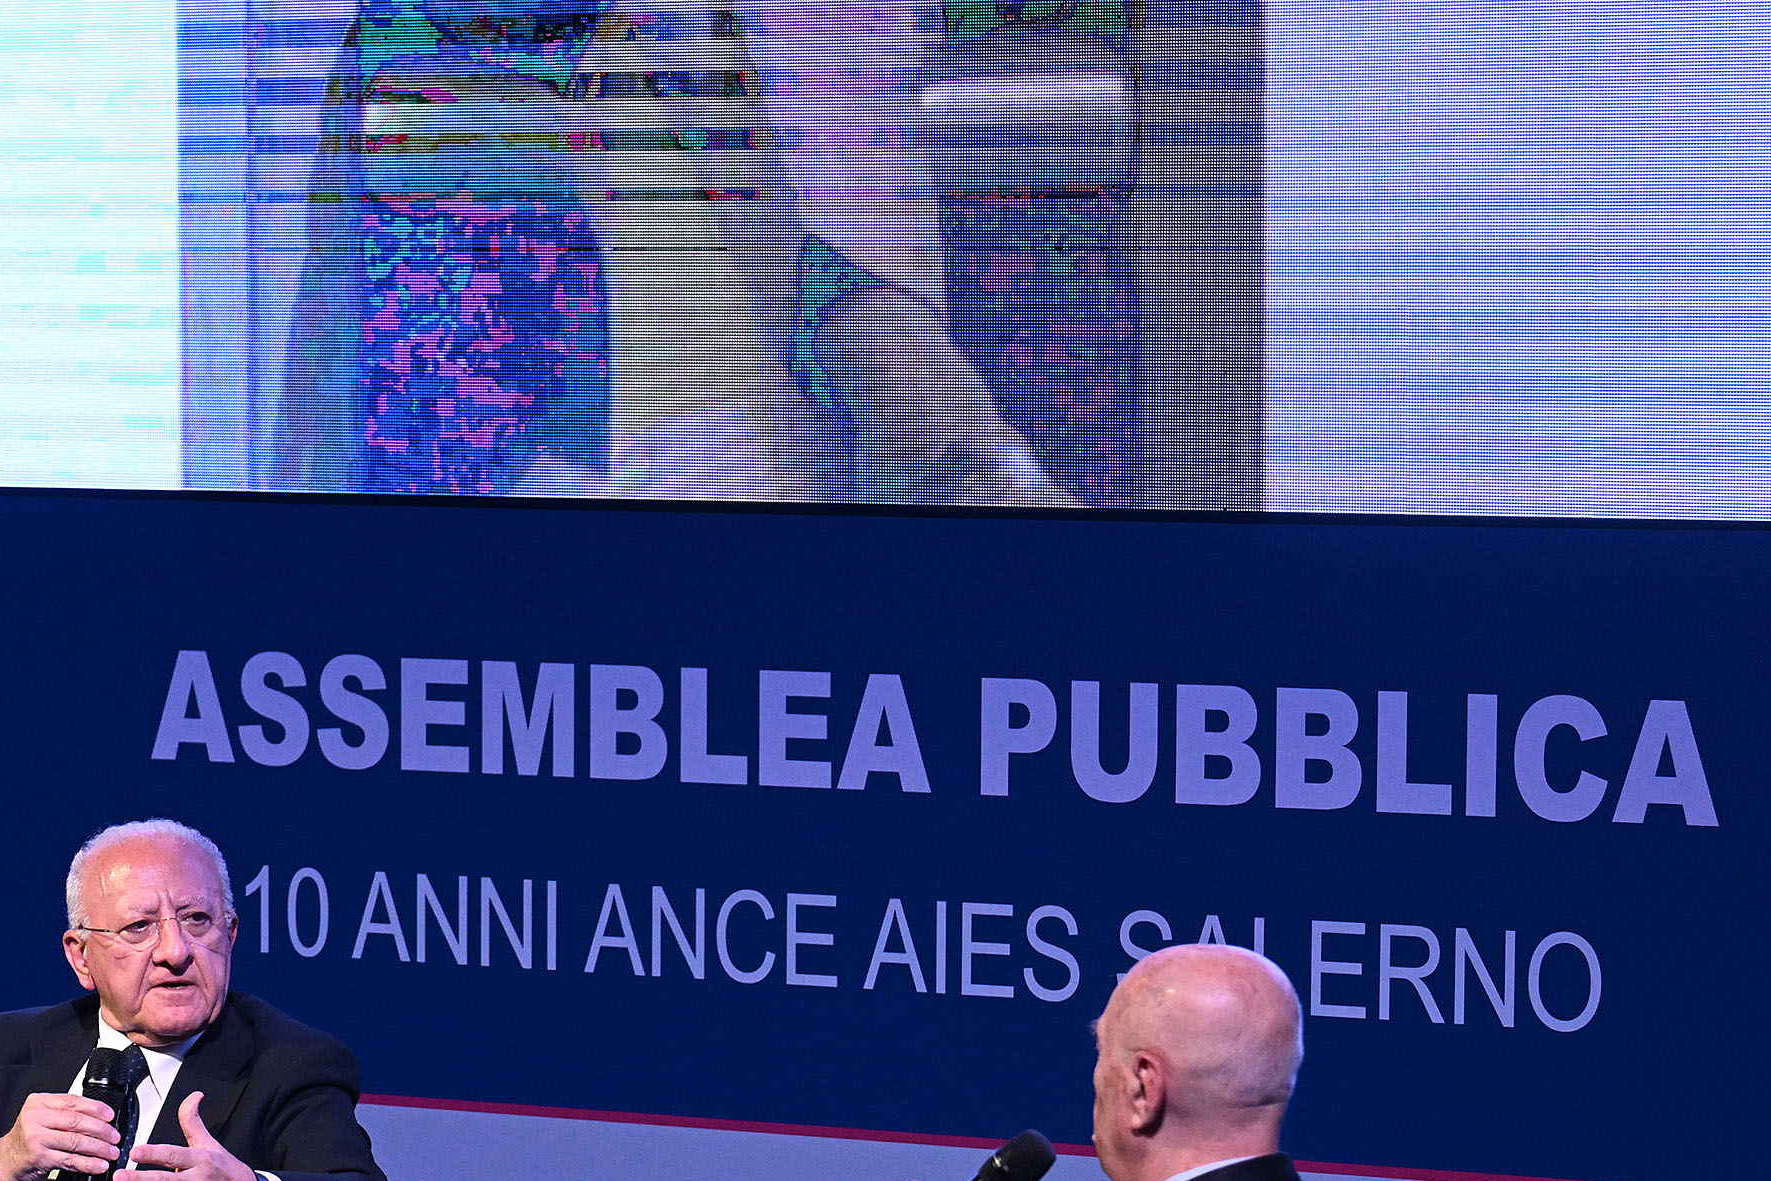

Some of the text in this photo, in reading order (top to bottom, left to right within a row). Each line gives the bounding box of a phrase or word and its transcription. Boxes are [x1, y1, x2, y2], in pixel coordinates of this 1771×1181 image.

[150, 650, 1720, 827] ASSEMBLEA PUBBLICA
[244, 864, 1602, 1033] 10 ANNI ANCE AIES SERNO
